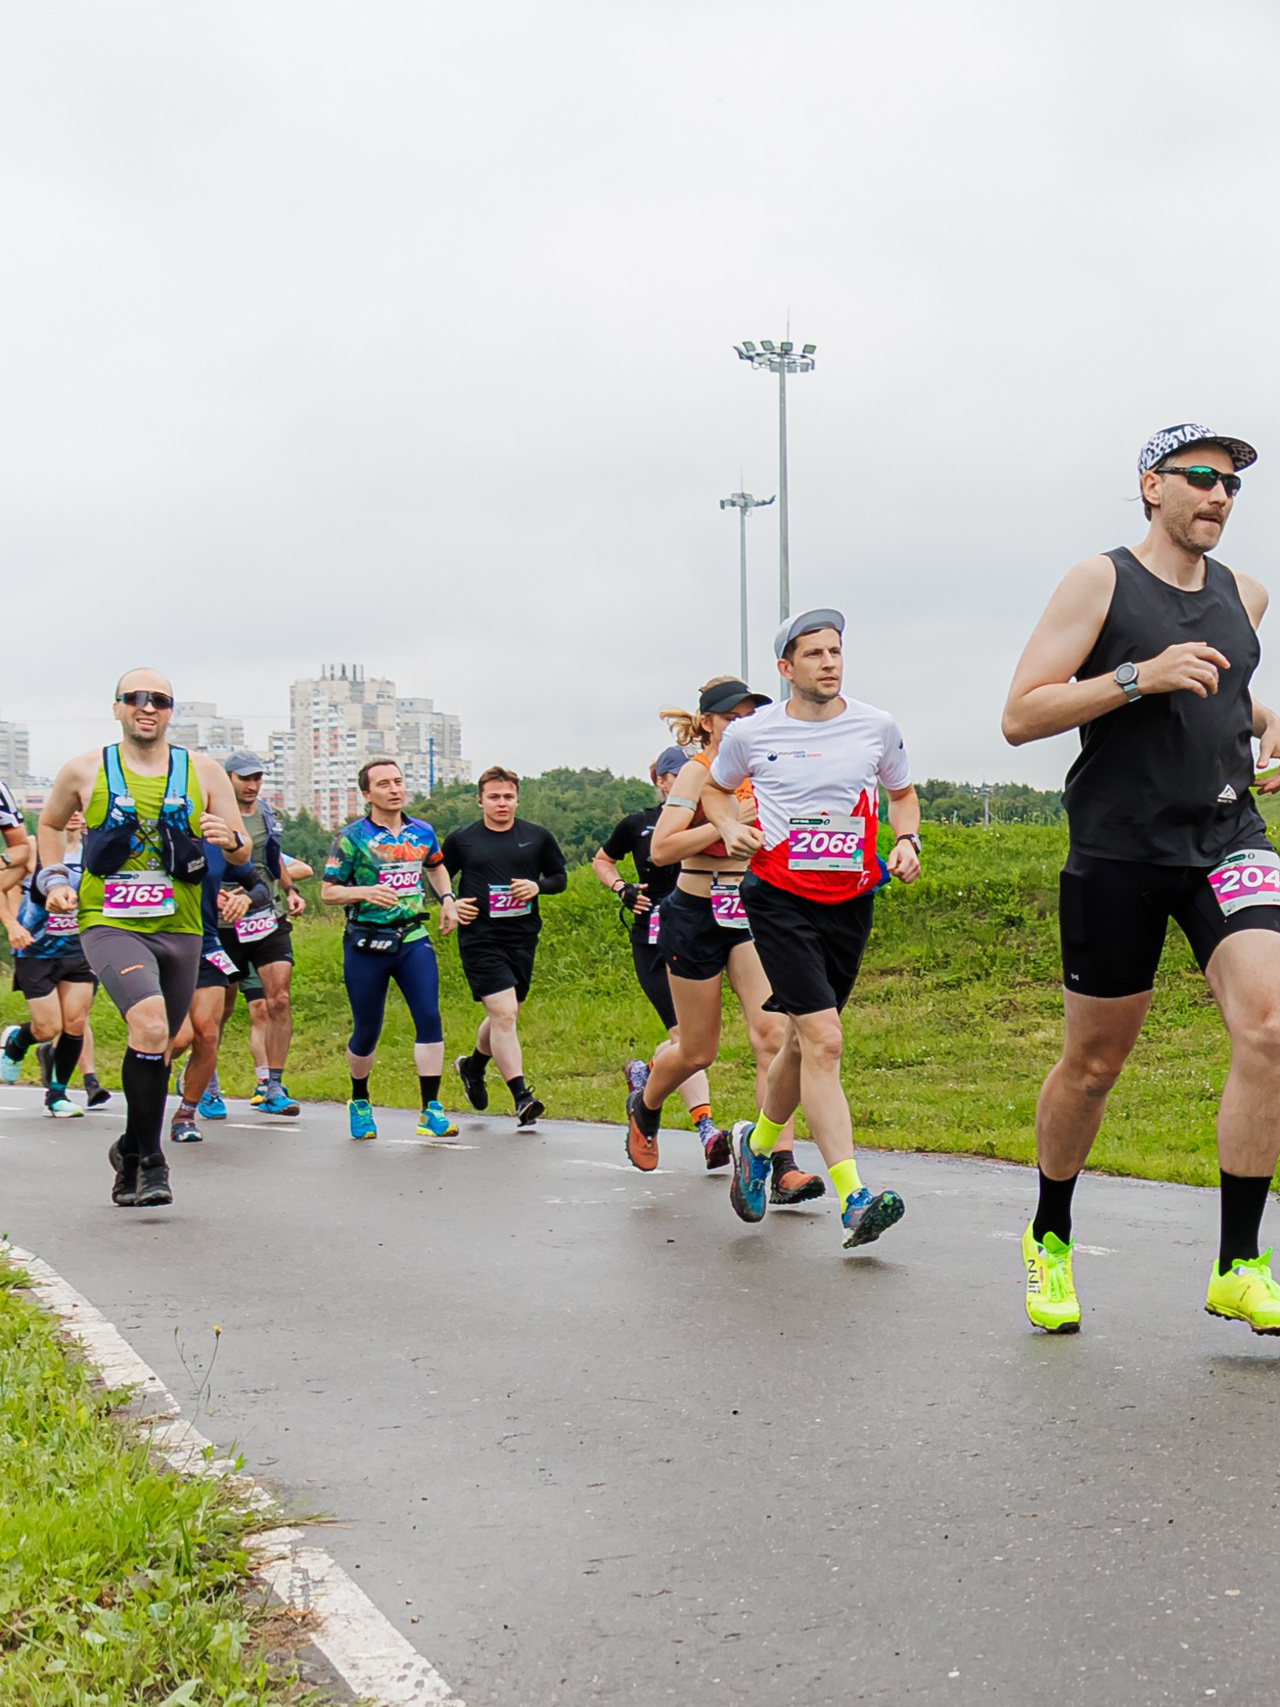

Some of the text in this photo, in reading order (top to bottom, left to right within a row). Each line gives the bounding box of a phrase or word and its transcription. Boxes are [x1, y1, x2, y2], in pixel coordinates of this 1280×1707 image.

[791, 832, 859, 854] 2068
[382, 872, 420, 887] 2080
[110, 885, 166, 903] 2165
[239, 917, 275, 933] 2006
